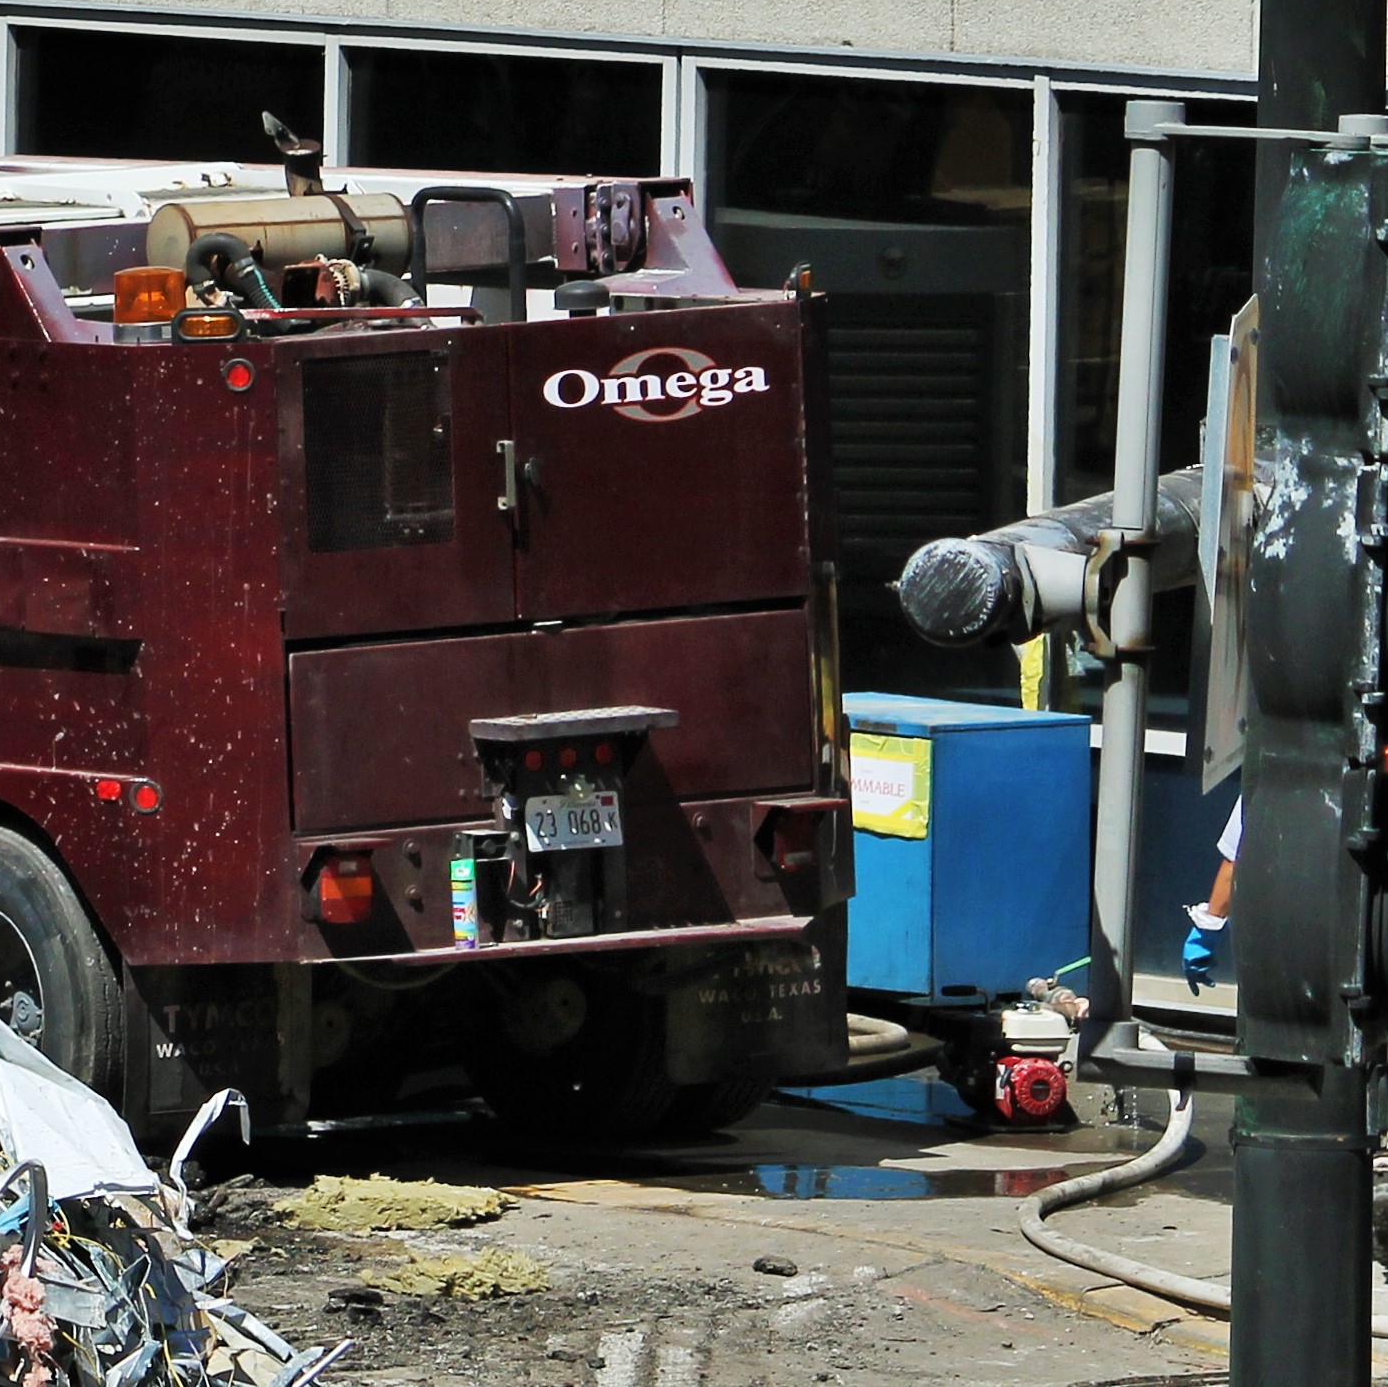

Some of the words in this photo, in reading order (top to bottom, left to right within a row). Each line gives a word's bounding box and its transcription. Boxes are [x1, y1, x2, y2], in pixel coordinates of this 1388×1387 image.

[542, 366, 771, 409] Omega
[535, 809, 558, 838] 23
[567, 808, 602, 836] 068
[607, 810, 618, 830] K
[698, 988, 757, 1005] WAO
[768, 979, 822, 999] TEXAS
[156, 1038, 217, 1060] WACO
